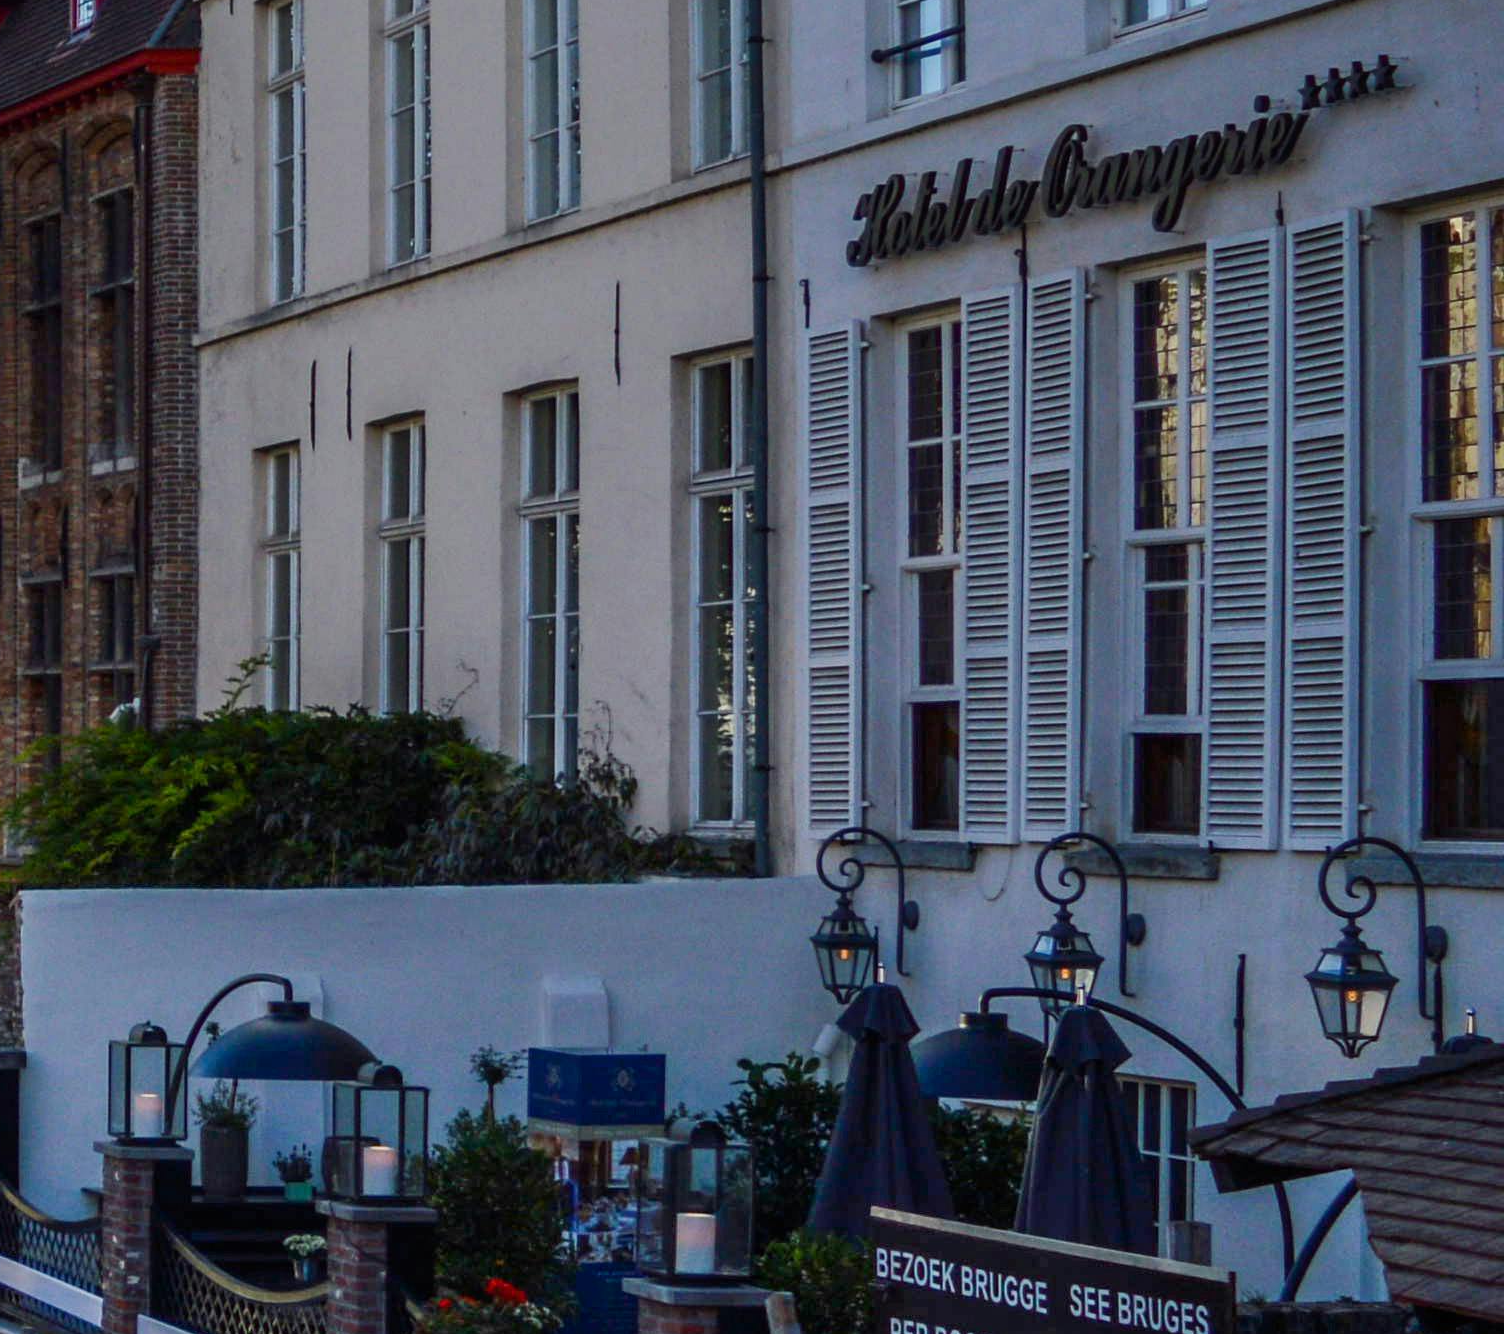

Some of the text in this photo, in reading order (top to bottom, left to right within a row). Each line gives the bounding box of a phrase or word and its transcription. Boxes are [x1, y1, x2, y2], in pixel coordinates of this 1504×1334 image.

[846, 94, 1310, 267] Hotel de Orangerie
[876, 1247, 1048, 1314] BEZOEK BRUGGE
[1070, 1284, 1111, 1322] SEE
